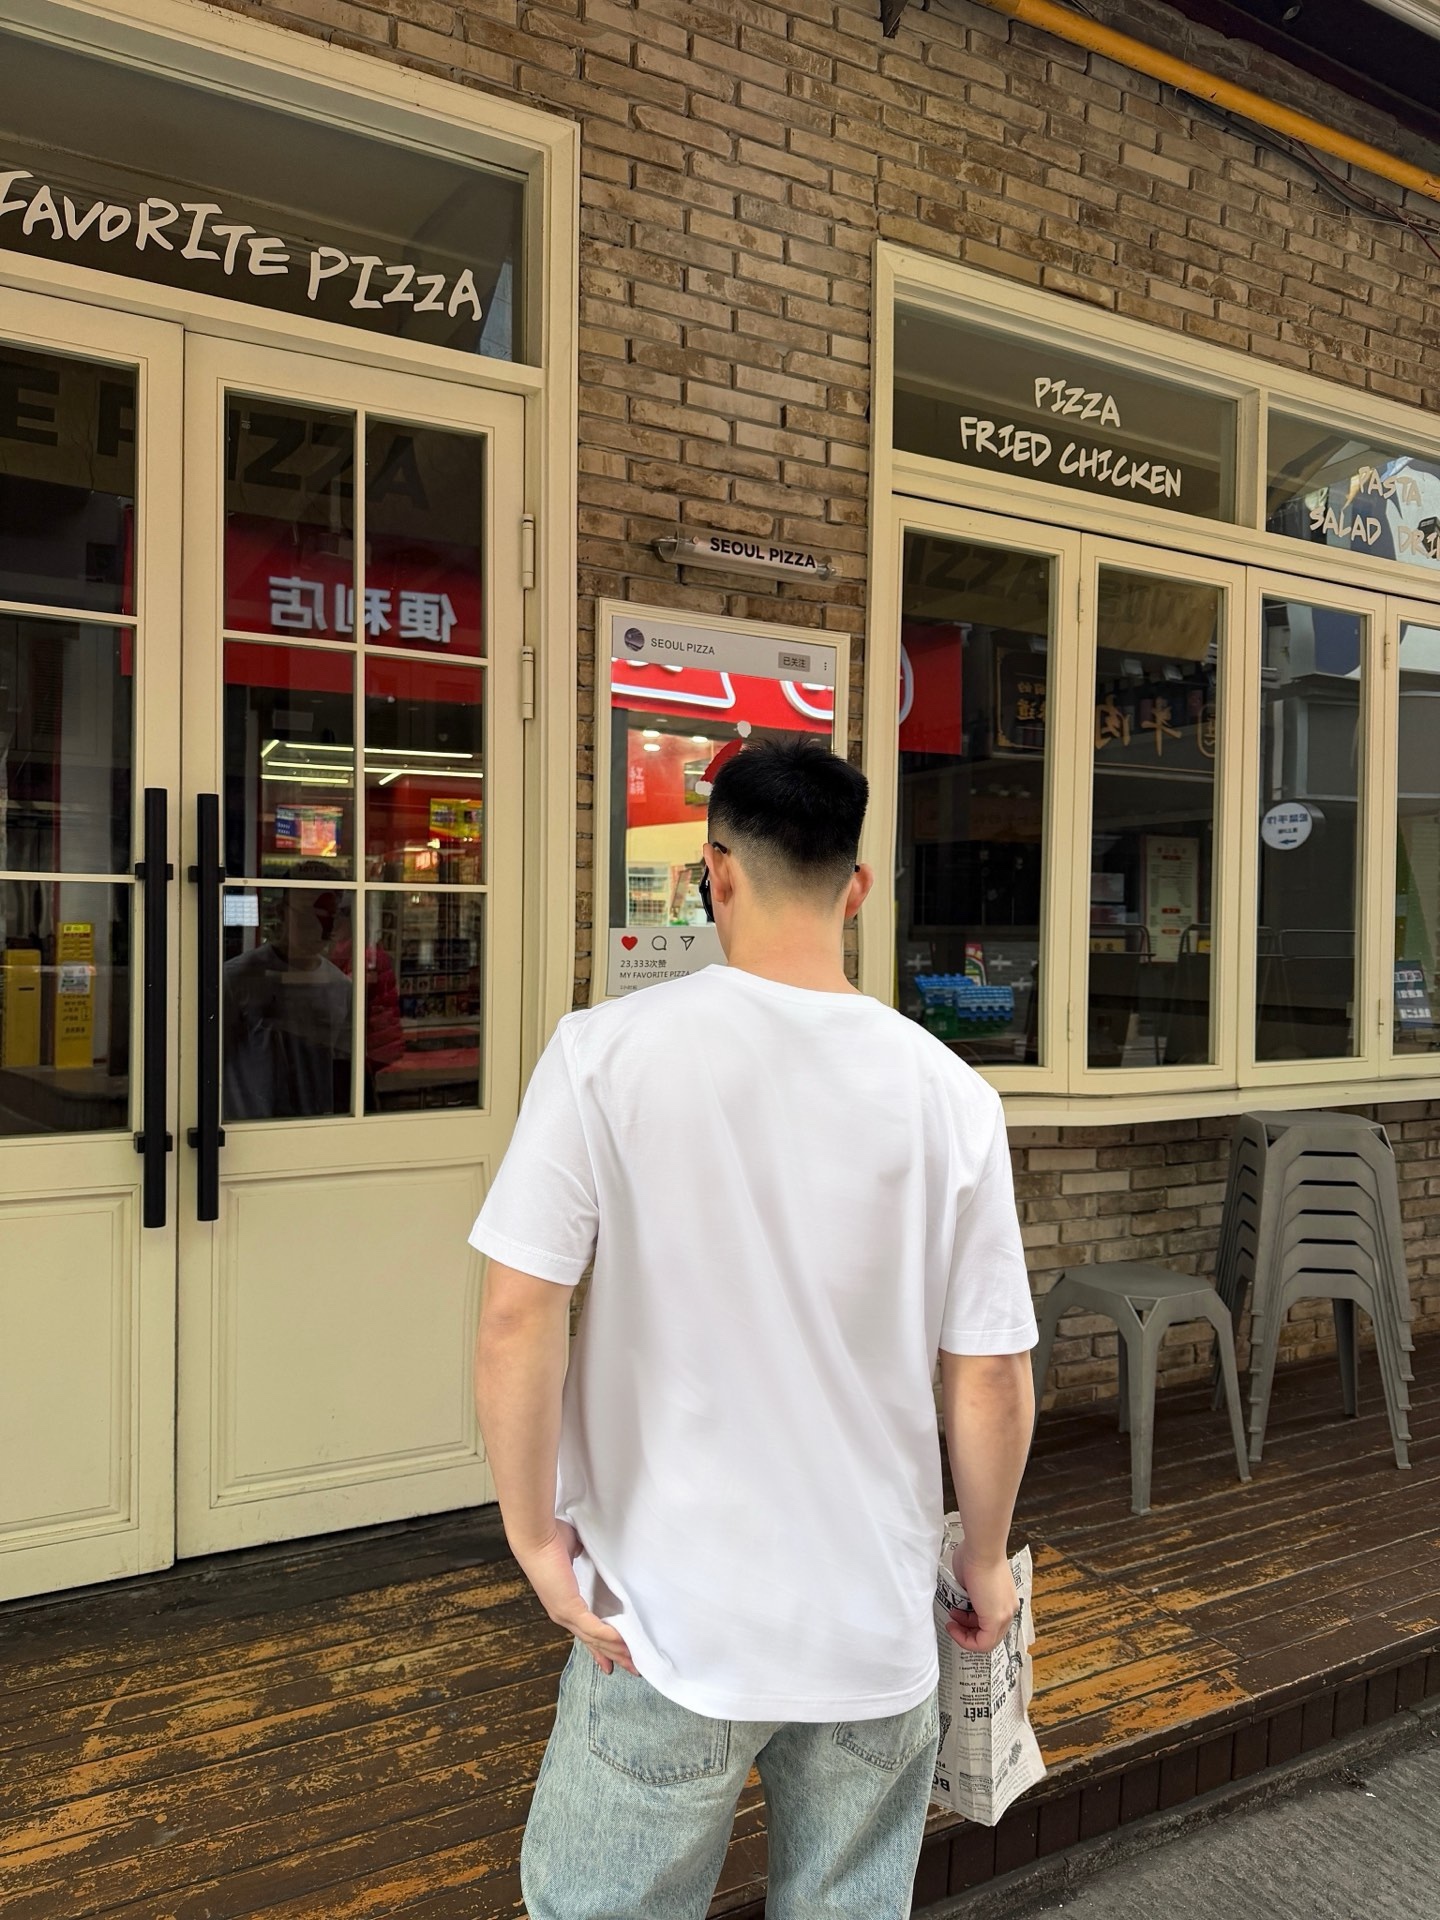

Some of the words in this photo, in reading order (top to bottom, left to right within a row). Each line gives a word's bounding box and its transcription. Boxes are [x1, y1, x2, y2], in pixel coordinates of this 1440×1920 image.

[0, 170, 291, 276] FAVORITE
[307, 247, 483, 321] PIZZA
[1034, 376, 1121, 428] PIZZA
[959, 416, 1052, 467] FRIED
[1058, 442, 1183, 498] CHICKEN
[1358, 466, 1422, 507] PASTA
[1308, 506, 1382, 546] SALAD
[709, 537, 765, 560] SEOUL
[768, 547, 817, 569] PIZZA
[650, 637, 686, 652] SEOUL
[686, 643, 716, 656] PIZZA
[783, 656, 807, 669] 已关注
[633, 971, 668, 979] FAVORITE
[669, 970, 691, 978] PIZZA
